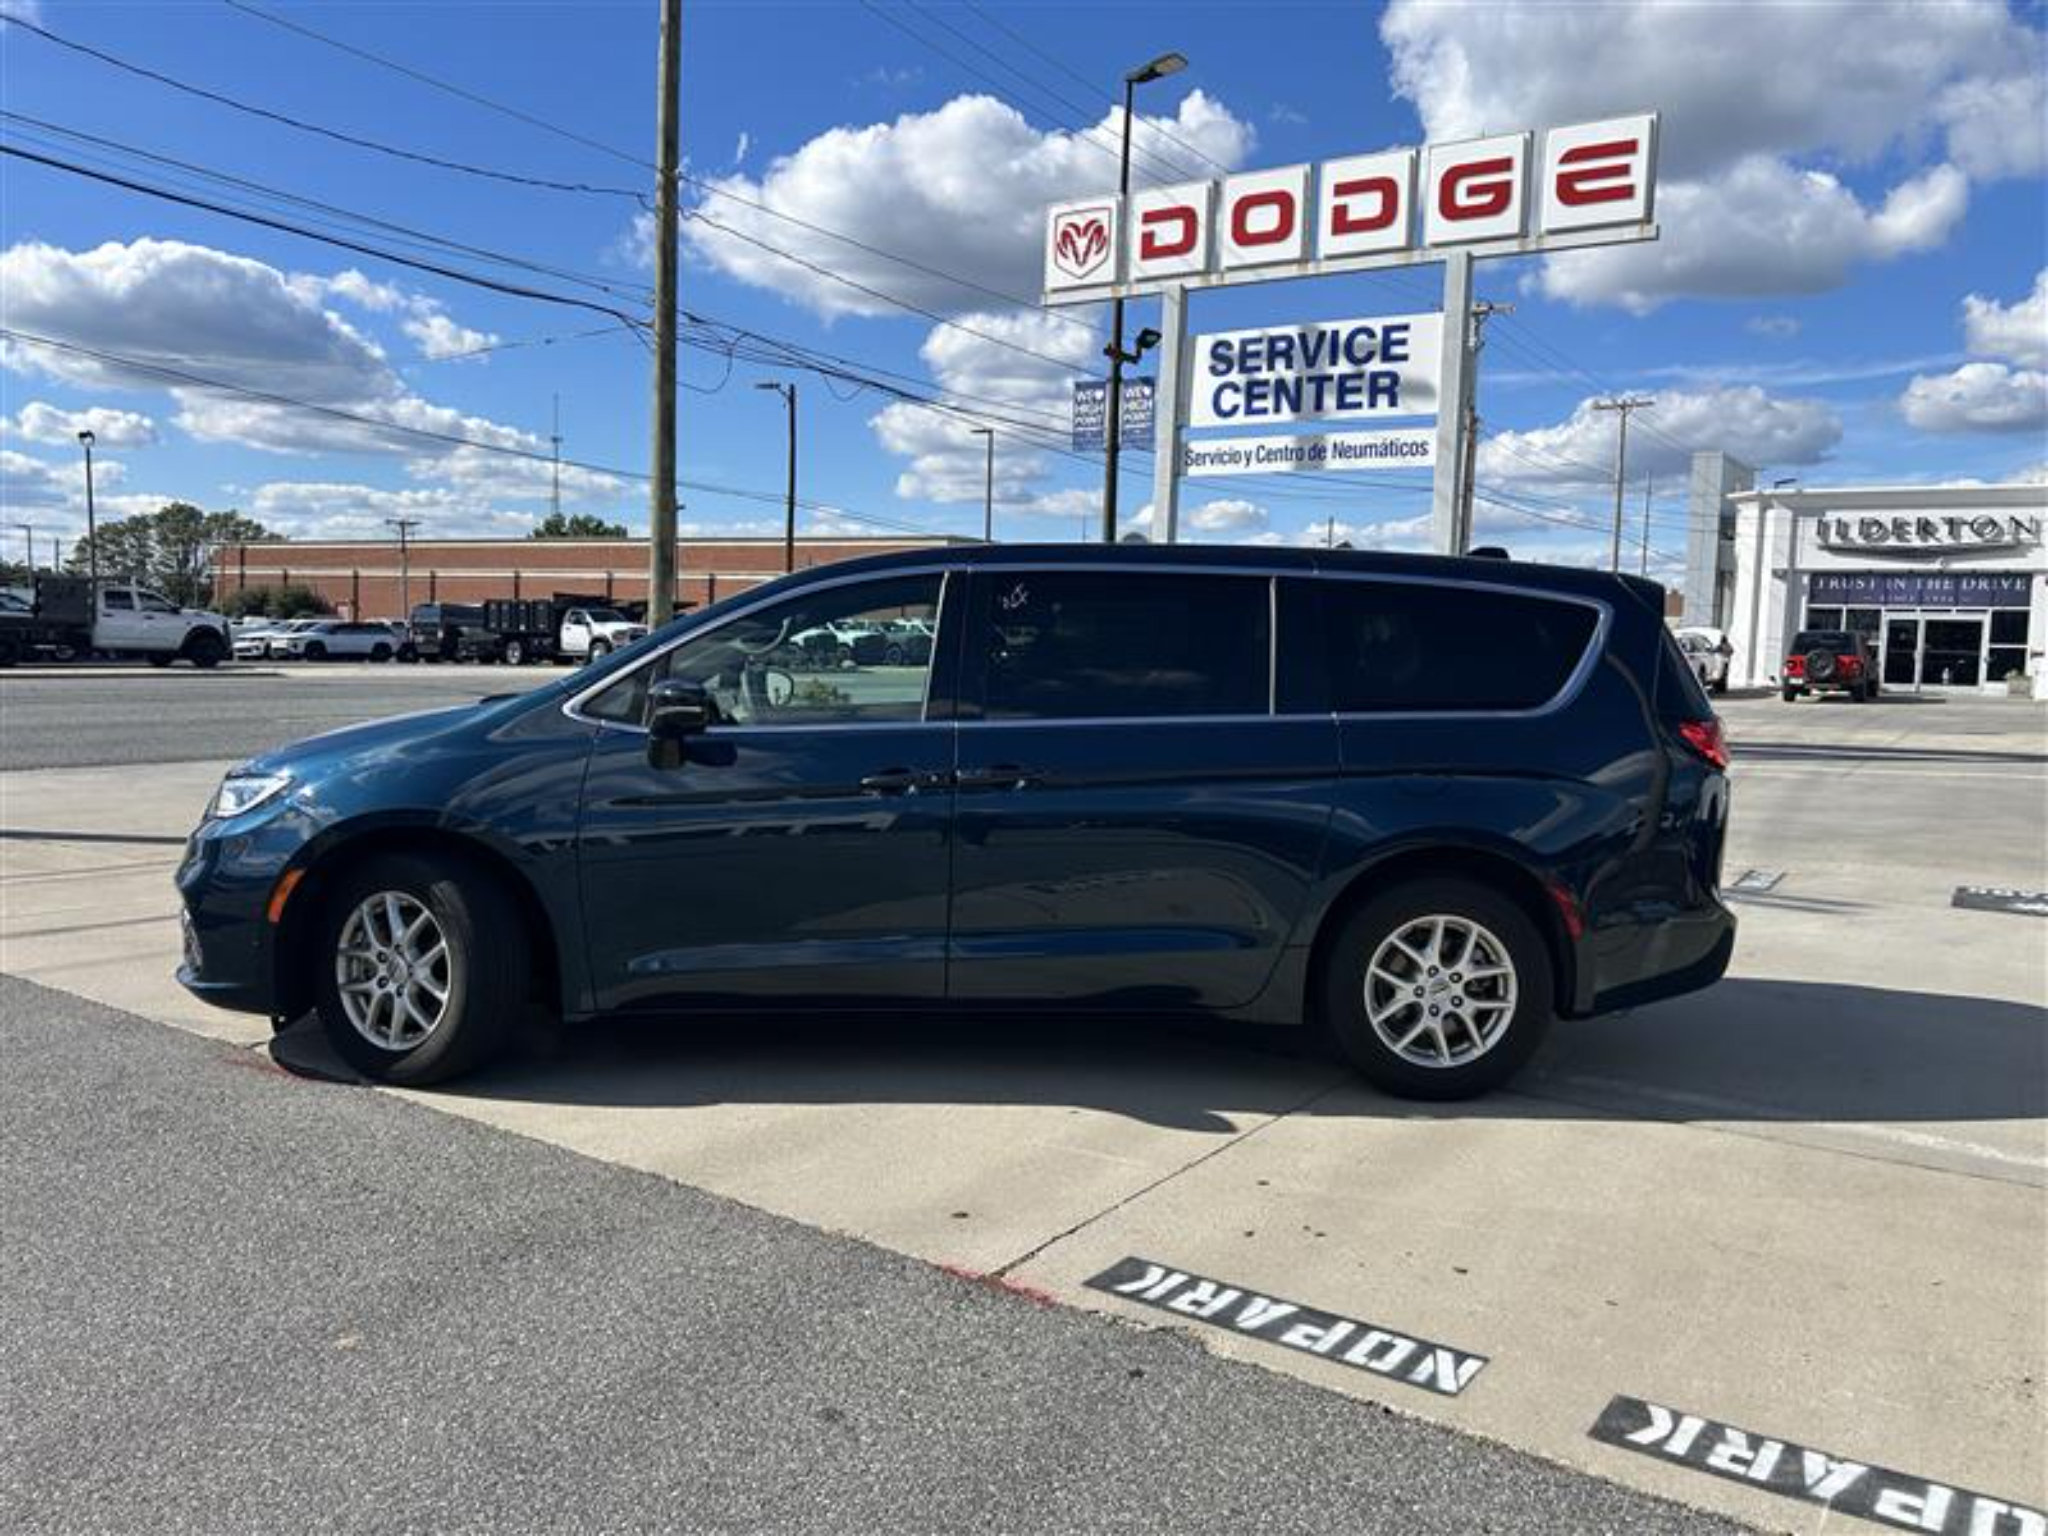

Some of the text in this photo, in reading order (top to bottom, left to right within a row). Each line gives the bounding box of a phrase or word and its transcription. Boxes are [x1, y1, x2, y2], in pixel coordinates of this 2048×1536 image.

[1140, 138, 1638, 262] DODGE
[1208, 323, 1411, 377] SERVICE
[1212, 370, 1400, 418] CENTER
[1184, 438, 1430, 467] Servicio y Centro de Neumáticos
[1818, 577, 2027, 591] TRUST IN THE DRIVE
